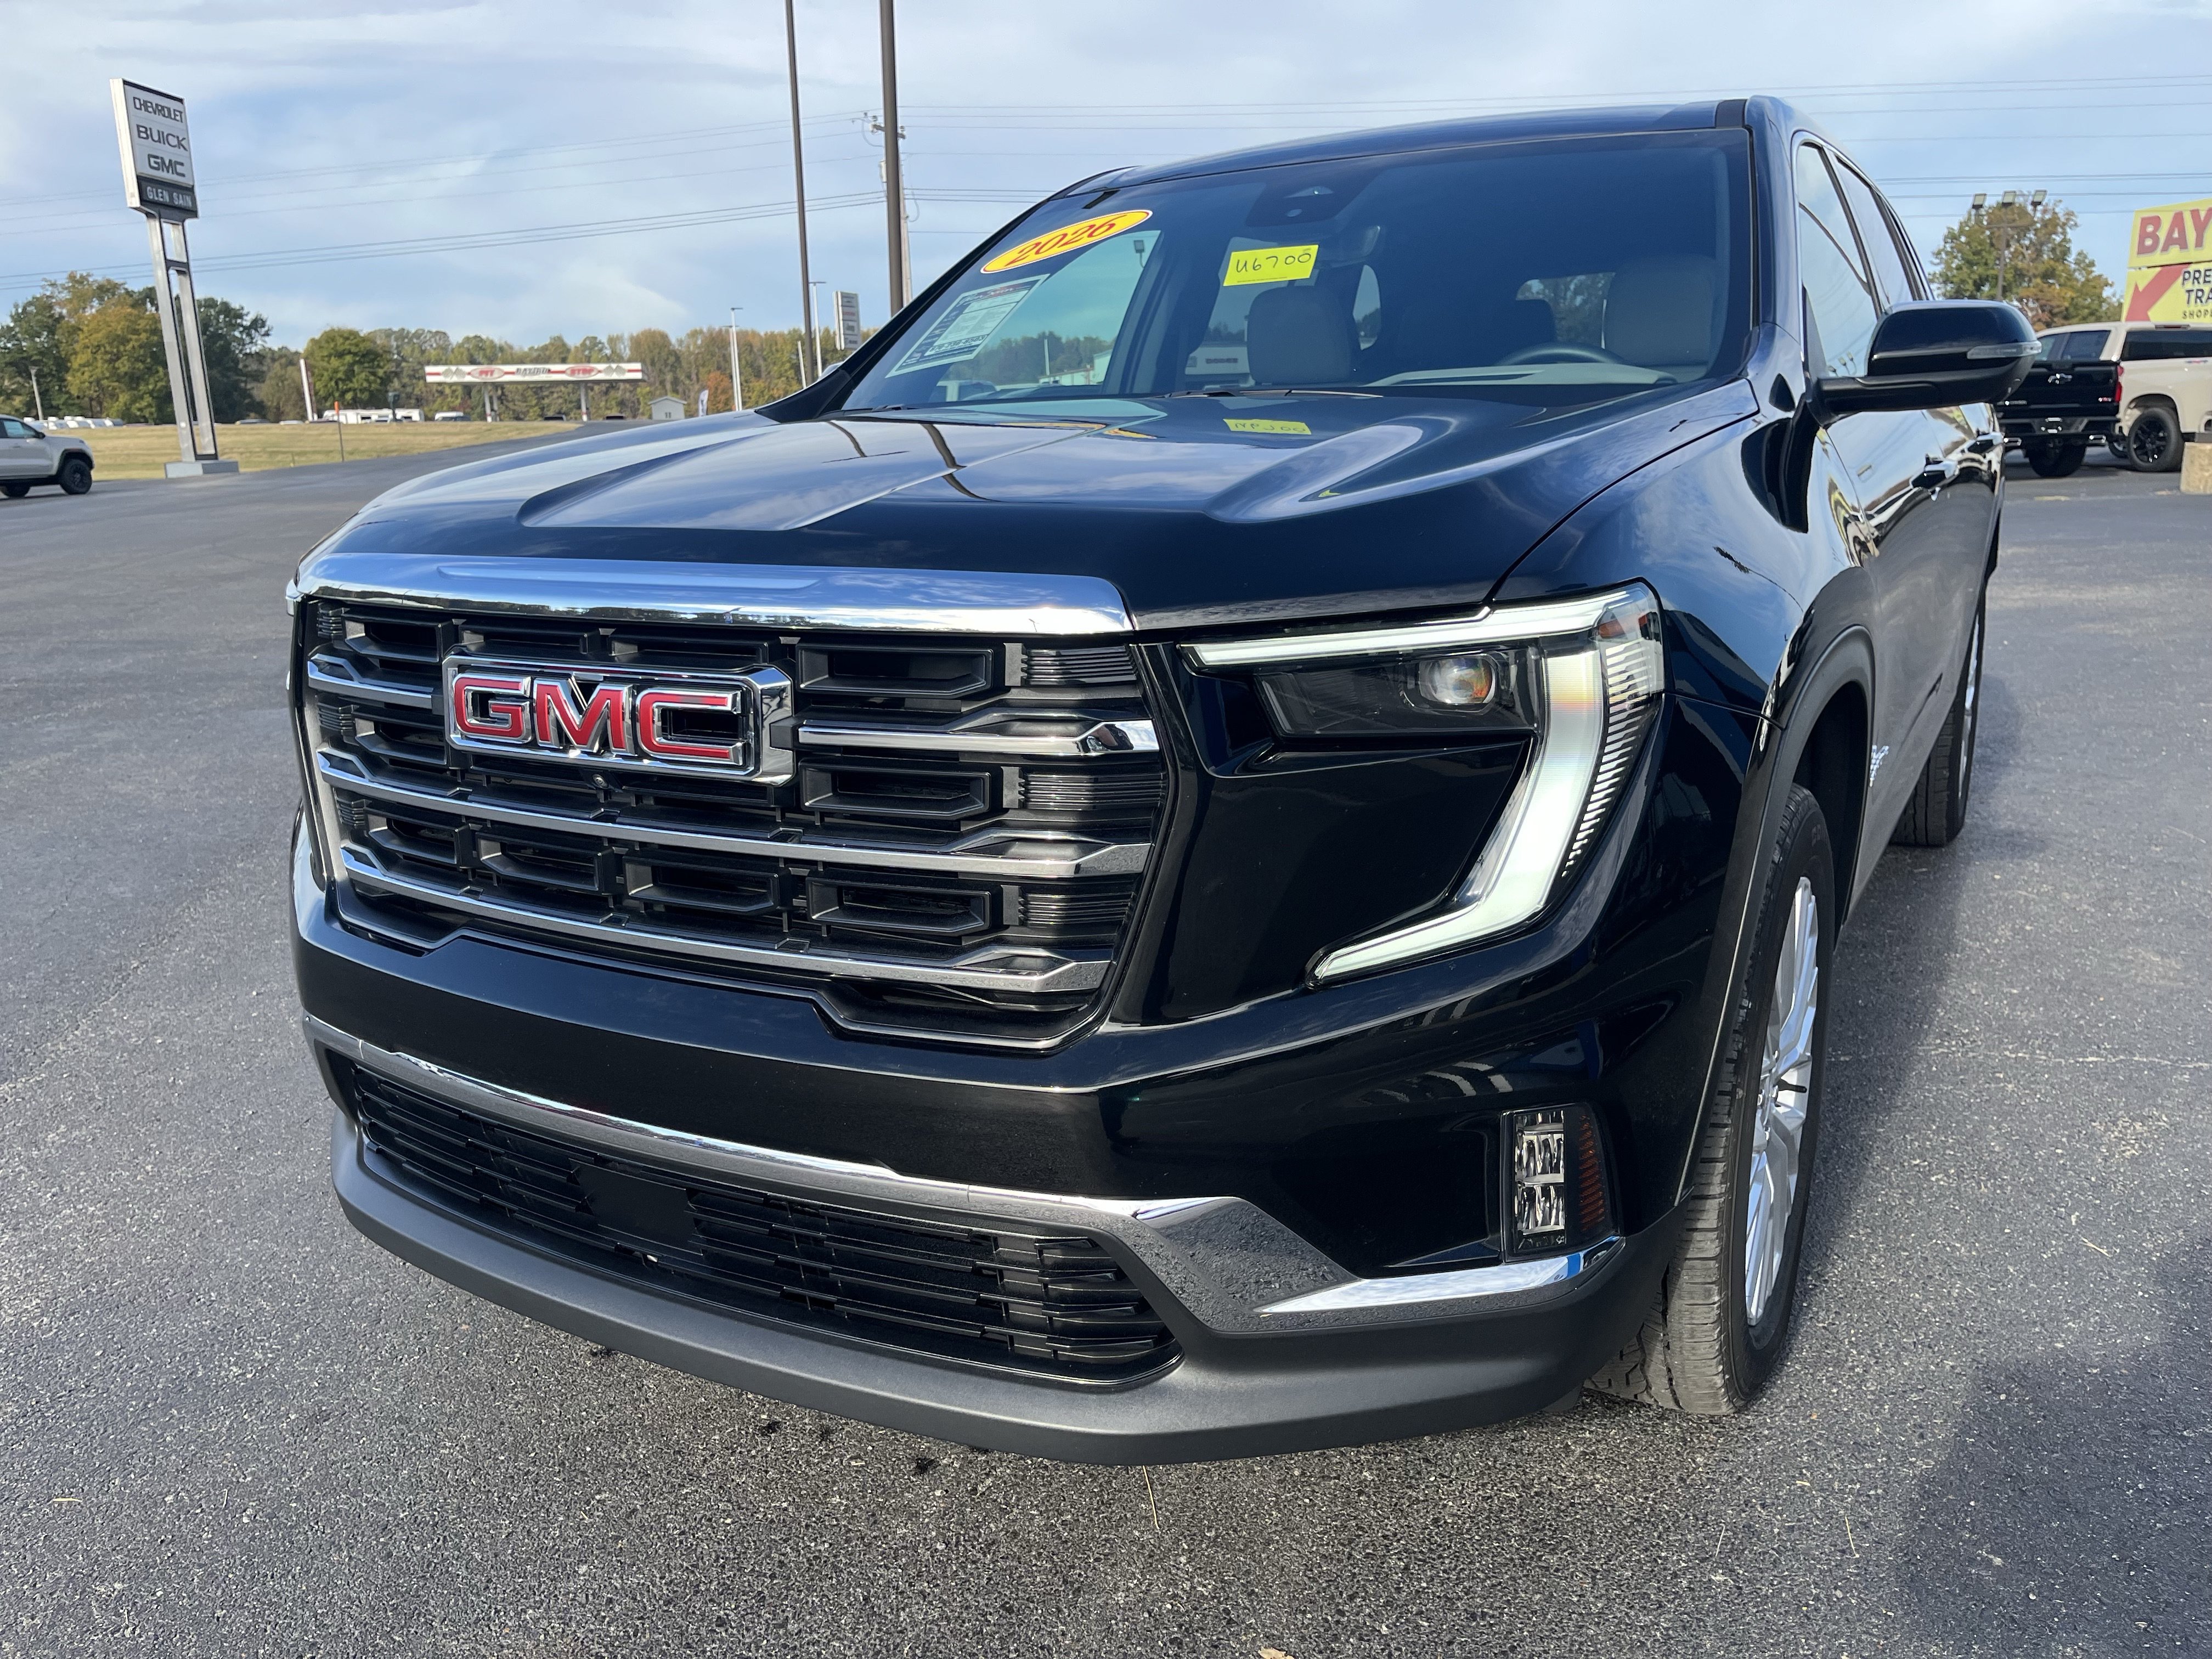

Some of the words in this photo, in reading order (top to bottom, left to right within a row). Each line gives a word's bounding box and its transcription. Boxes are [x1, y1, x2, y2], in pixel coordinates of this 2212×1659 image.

[133, 97, 184, 123] CHEVROLET
[136, 124, 188, 151] BUICK
[148, 154, 186, 177] GMC
[146, 186, 170, 202] GLEN
[173, 192, 193, 207] SAIN
[1005, 214, 1128, 267] 2026
[1236, 253, 1311, 273] U6700
[454, 670, 743, 766] GMC
